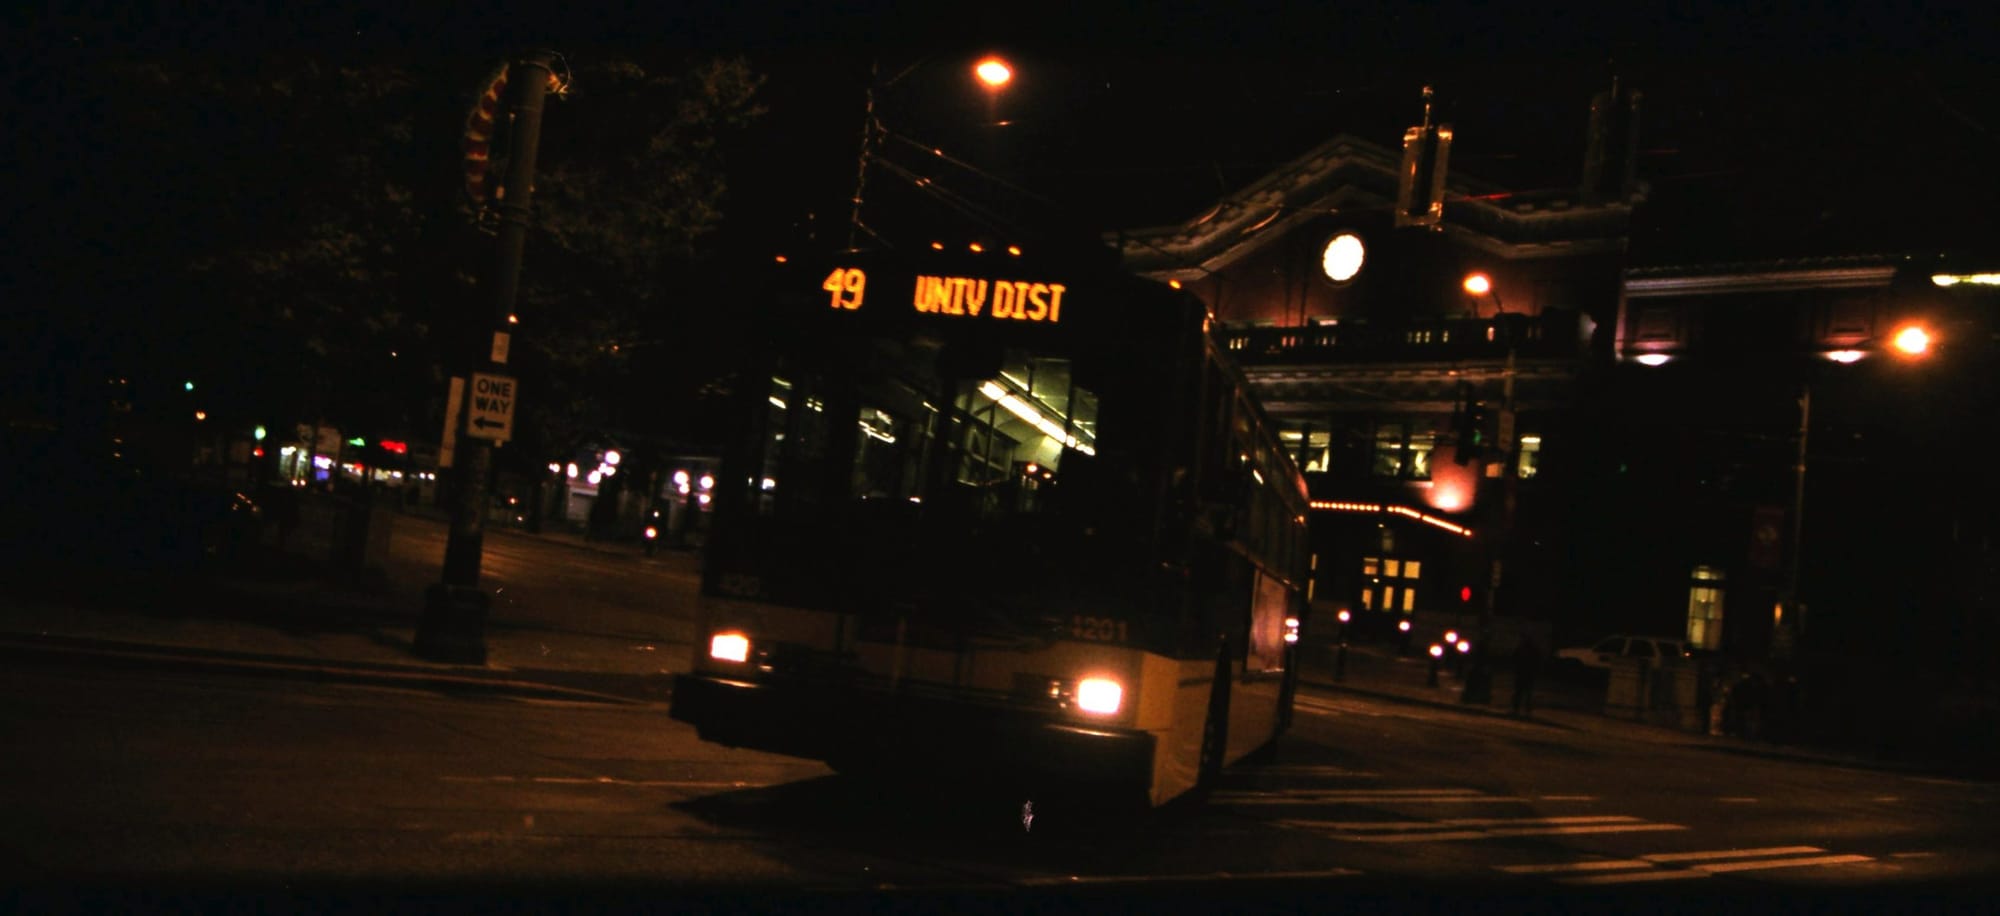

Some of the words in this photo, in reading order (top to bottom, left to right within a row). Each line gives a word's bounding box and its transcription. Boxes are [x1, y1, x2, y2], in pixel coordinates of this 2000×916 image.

[822, 268, 866, 310] 49
[914, 275, 988, 316] UNIV
[991, 280, 1066, 322] DIST
[478, 379, 512, 397] ONE
[475, 396, 510, 414] WAY
